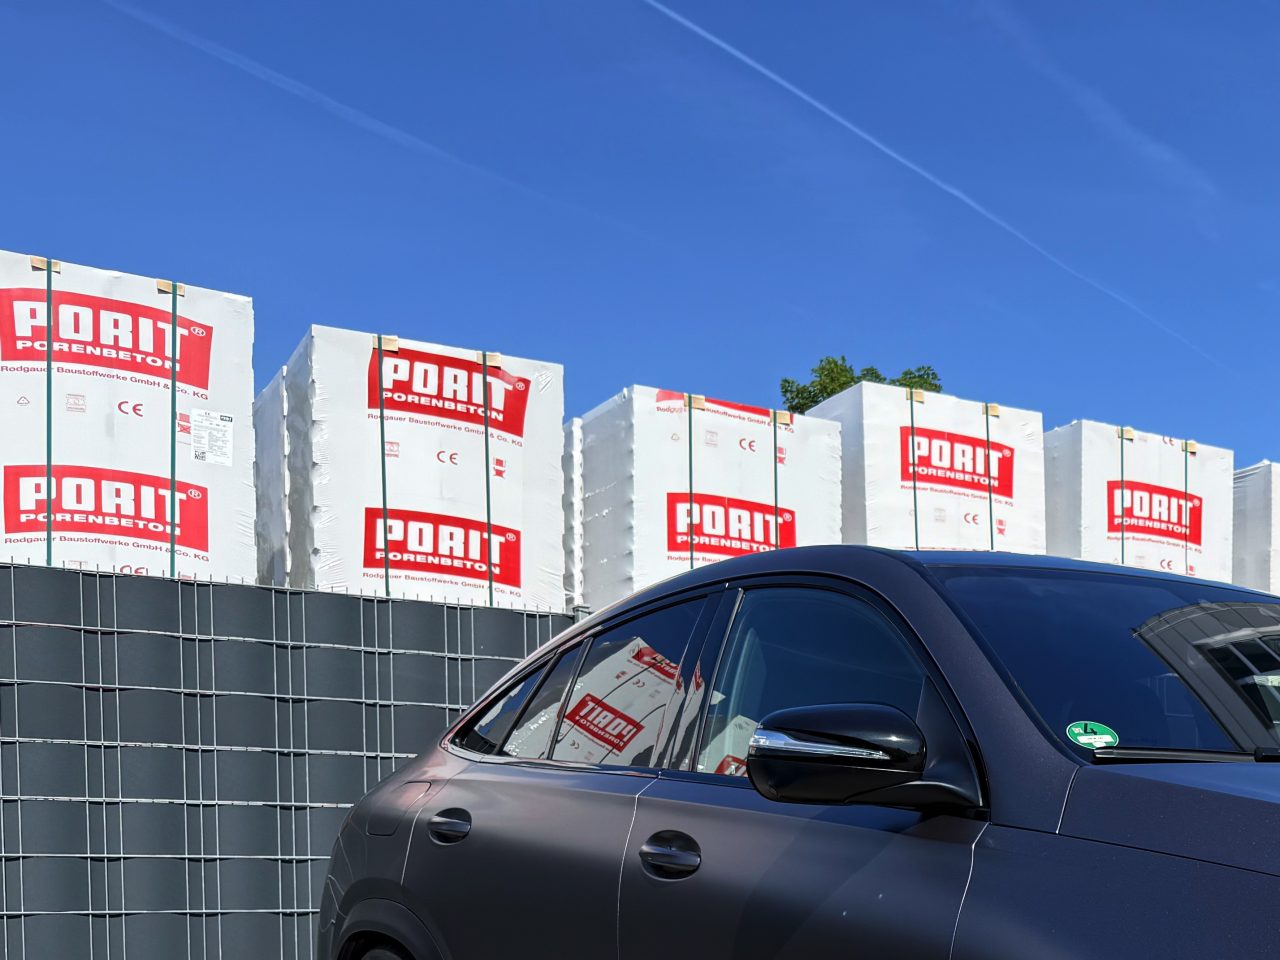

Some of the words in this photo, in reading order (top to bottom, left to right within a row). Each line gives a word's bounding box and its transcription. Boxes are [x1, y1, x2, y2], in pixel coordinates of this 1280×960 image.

[16, 340, 180, 372] PORENBETON
[56, 366, 128, 381] Baustoffwerke
[130, 376, 161, 388] GmbH
[192, 390, 209, 400] KG
[383, 392, 504, 422] PORENBETON
[368, 413, 406, 422] Rogauer
[408, 416, 462, 431] Baustoffwerke
[20, 513, 181, 537] PORENBETON
[5, 537, 56, 545] Rodgaur
[59, 536, 130, 547] Baustoffwerke
[132, 542, 163, 552] GmbH
[194, 553, 210, 562] KG
[677, 535, 777, 553] PORENBETO
[375, 551, 500, 575] PORENBETON
[363, 572, 402, 580] Rodguer
